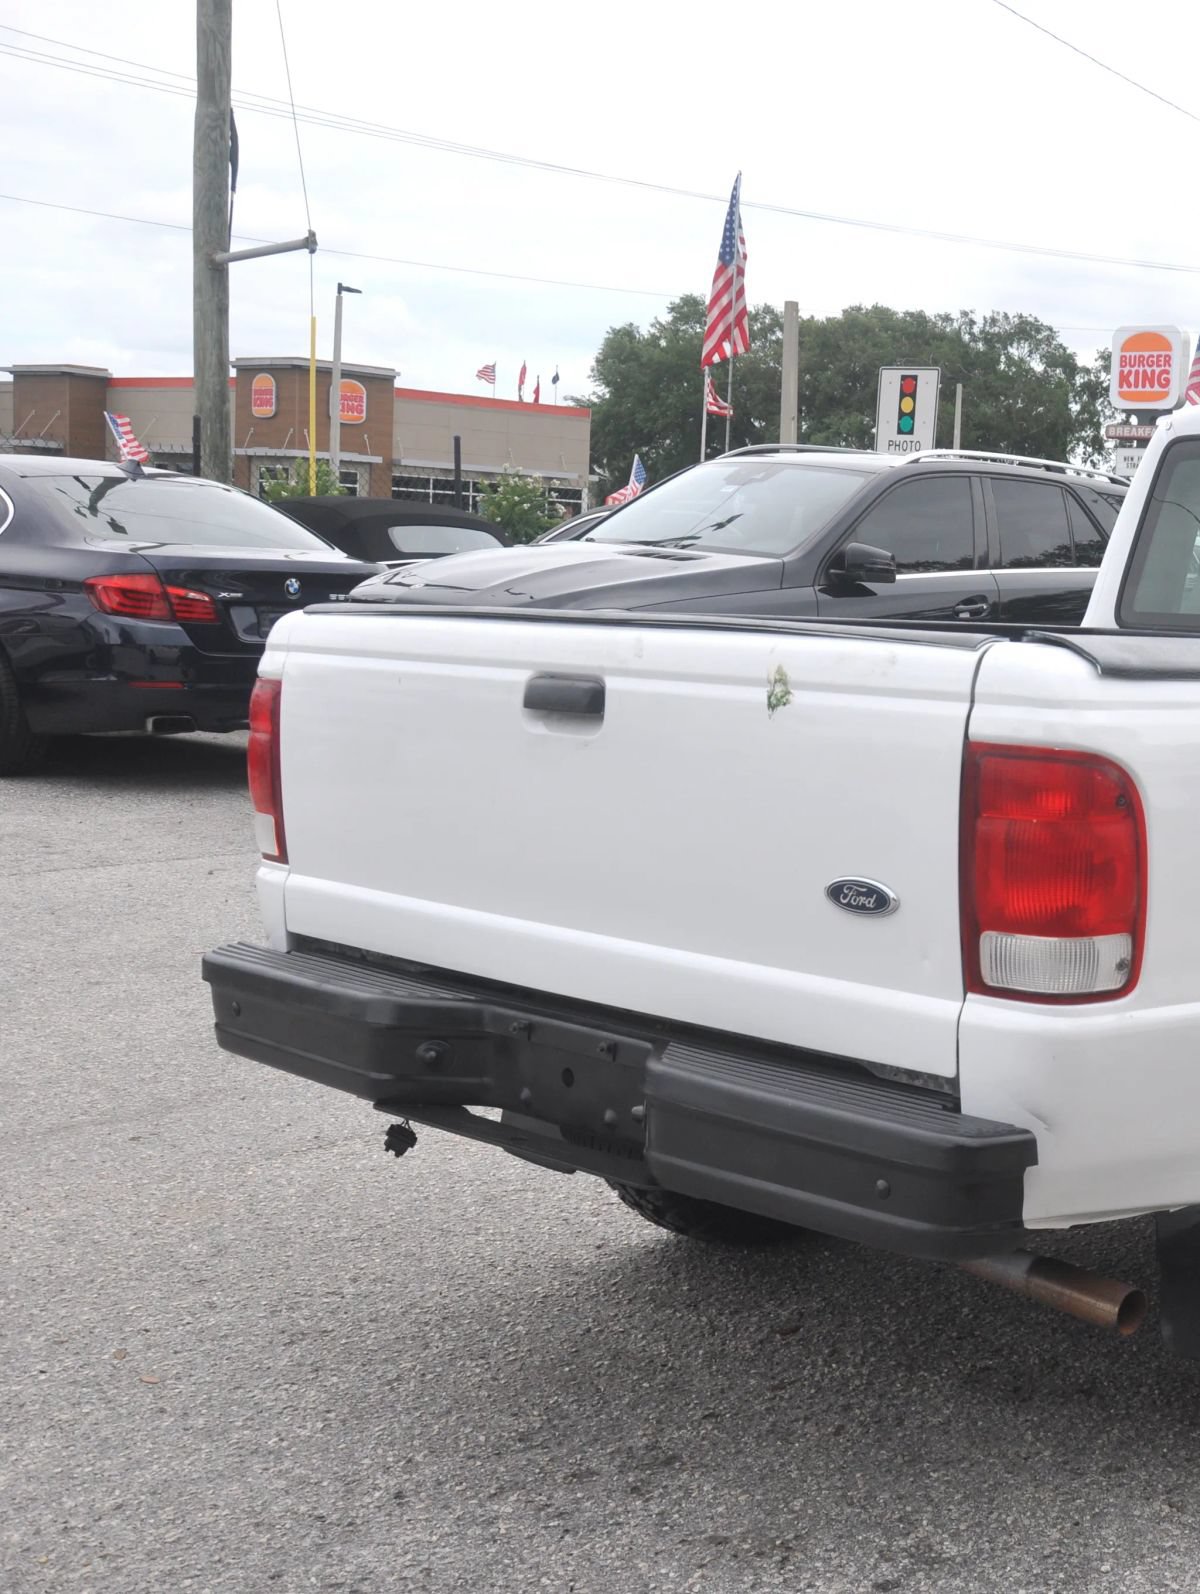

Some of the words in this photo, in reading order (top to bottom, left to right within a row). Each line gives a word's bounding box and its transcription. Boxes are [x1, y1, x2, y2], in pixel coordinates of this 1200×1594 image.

[1119, 353, 1172, 369] BURGER
[1118, 368, 1171, 390] KING
[339, 402, 364, 415] ING
[887, 439, 921, 452] PHOTO
[839, 884, 877, 908] Ford
